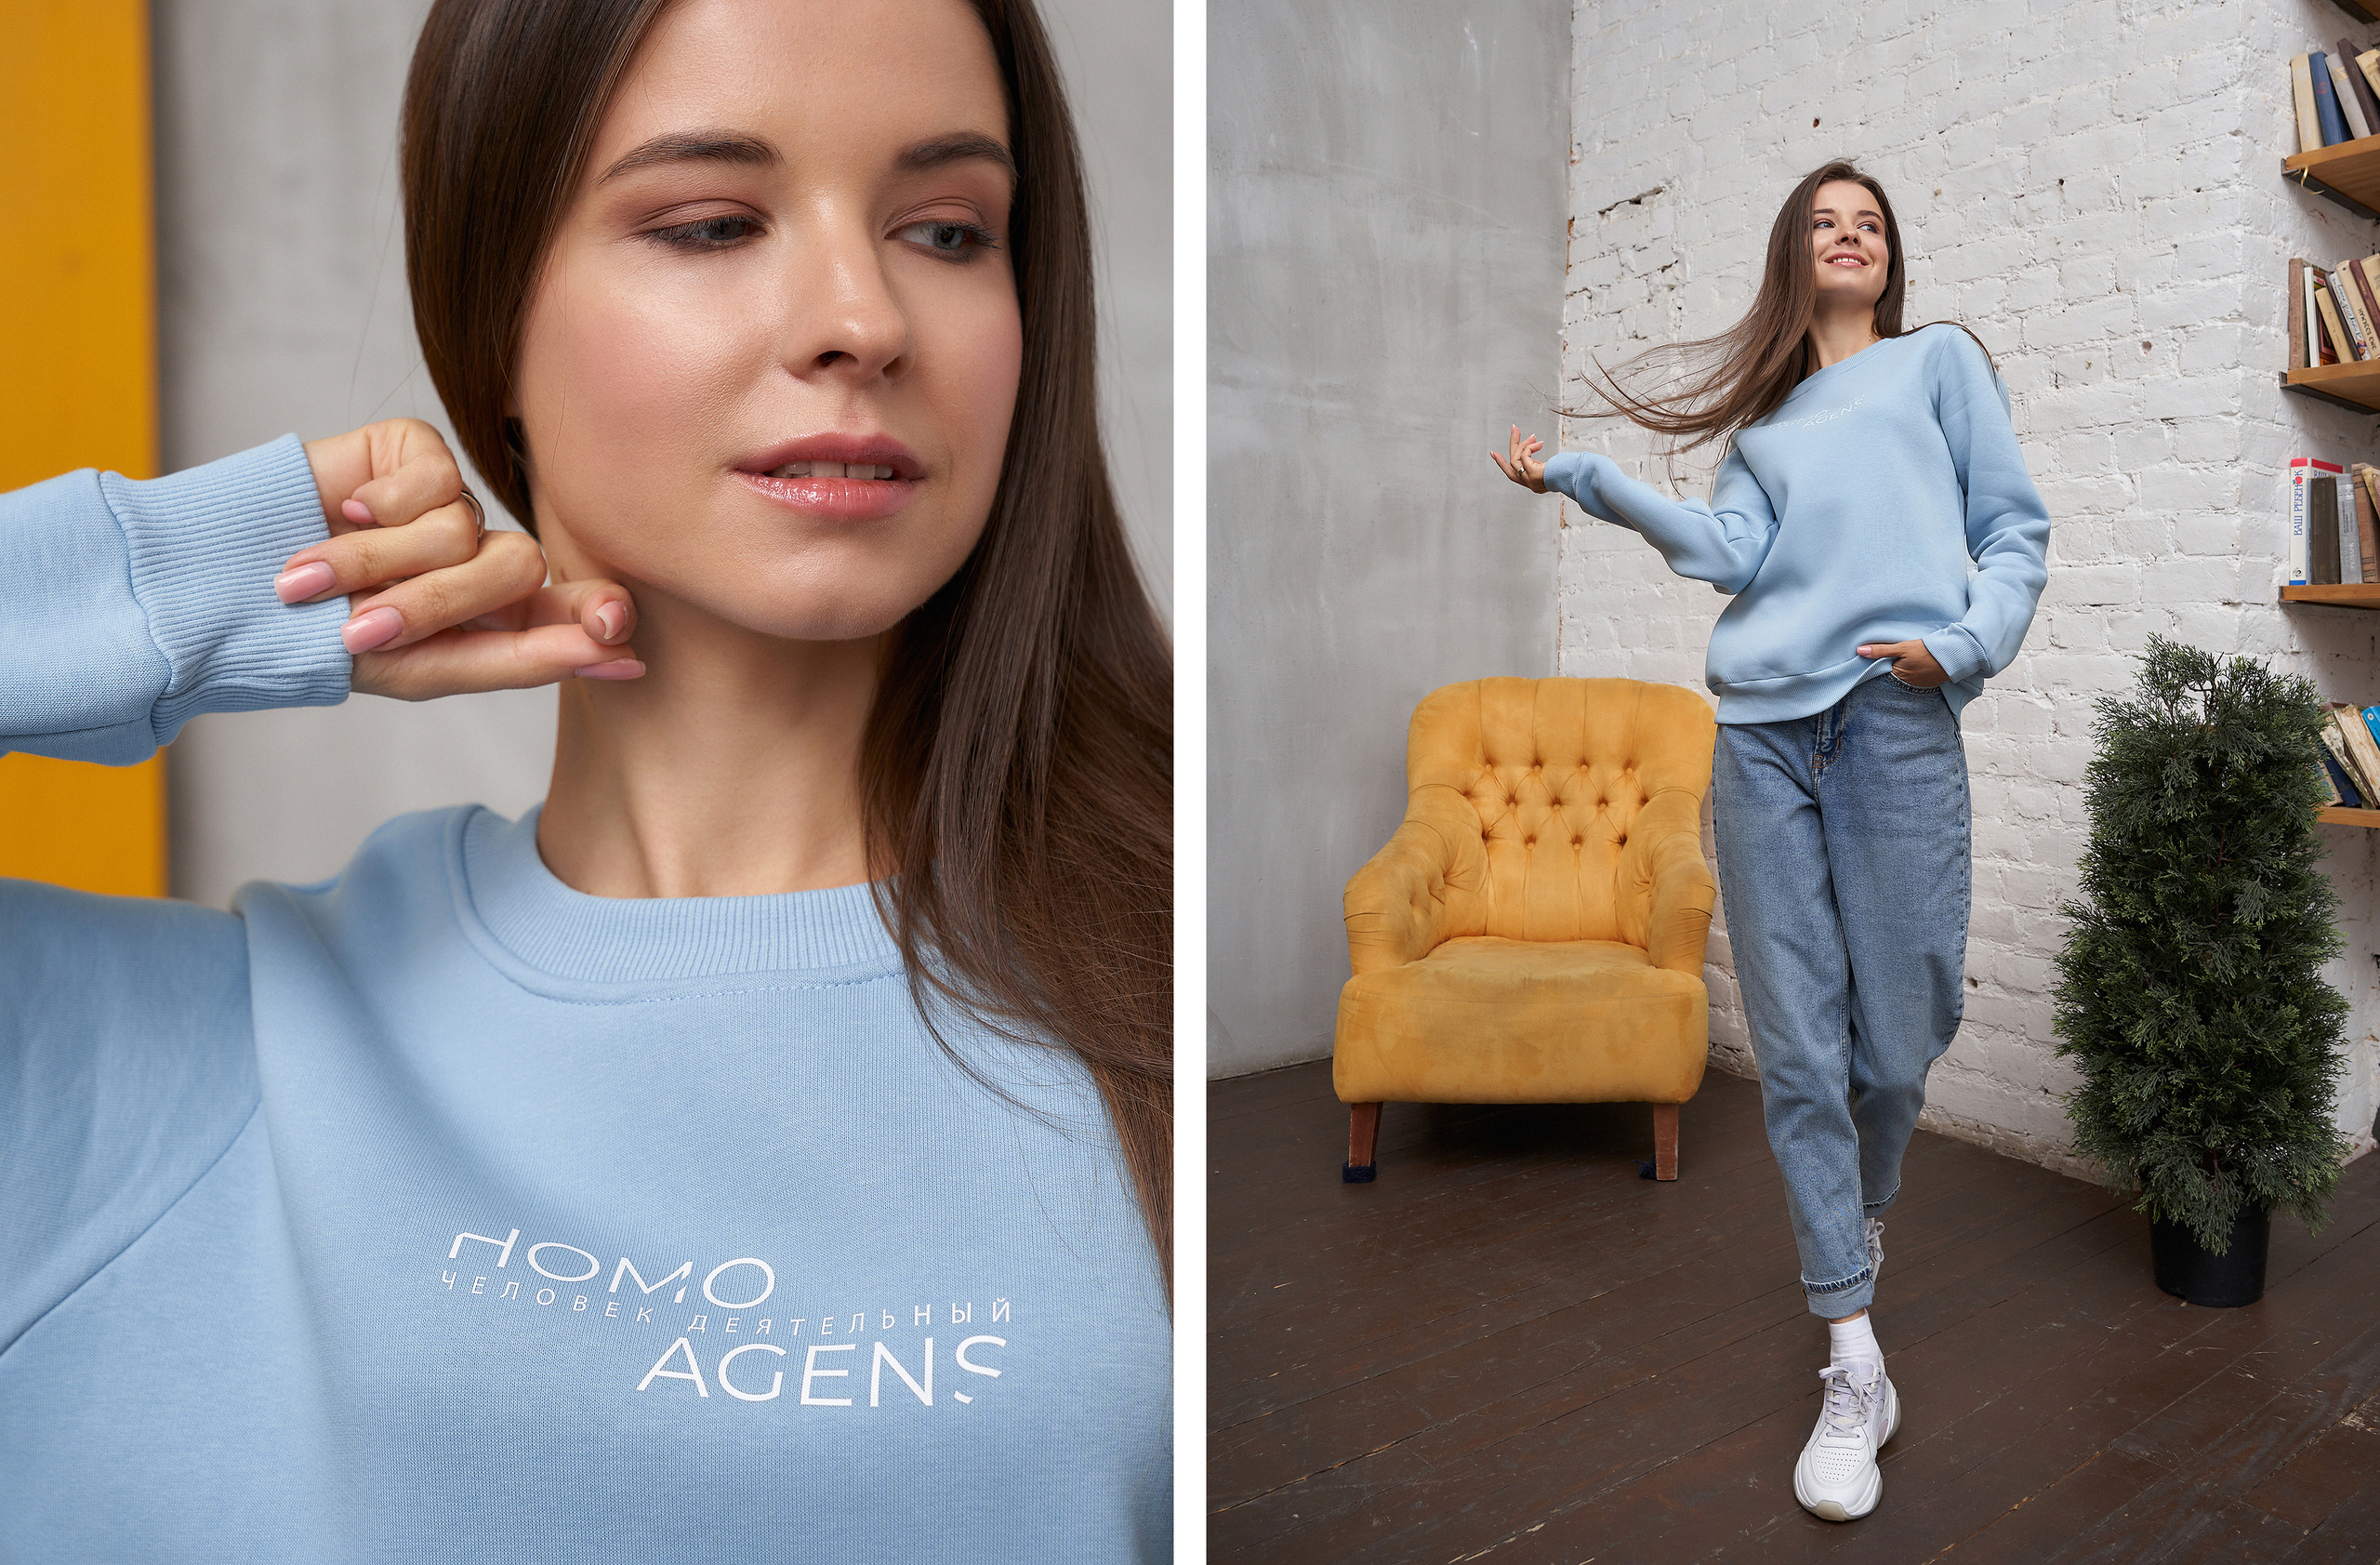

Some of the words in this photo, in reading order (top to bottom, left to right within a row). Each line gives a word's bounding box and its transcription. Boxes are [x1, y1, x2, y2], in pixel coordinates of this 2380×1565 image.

[2294, 515, 2303, 536] ВАШ
[441, 1269, 654, 1324] ЧЕЛОВЕК
[687, 1296, 1012, 1336] ДЕЯТЕЛЬНЫЙ
[448, 1228, 775, 1309] HOMO
[636, 1334, 1007, 1408] AGENS
